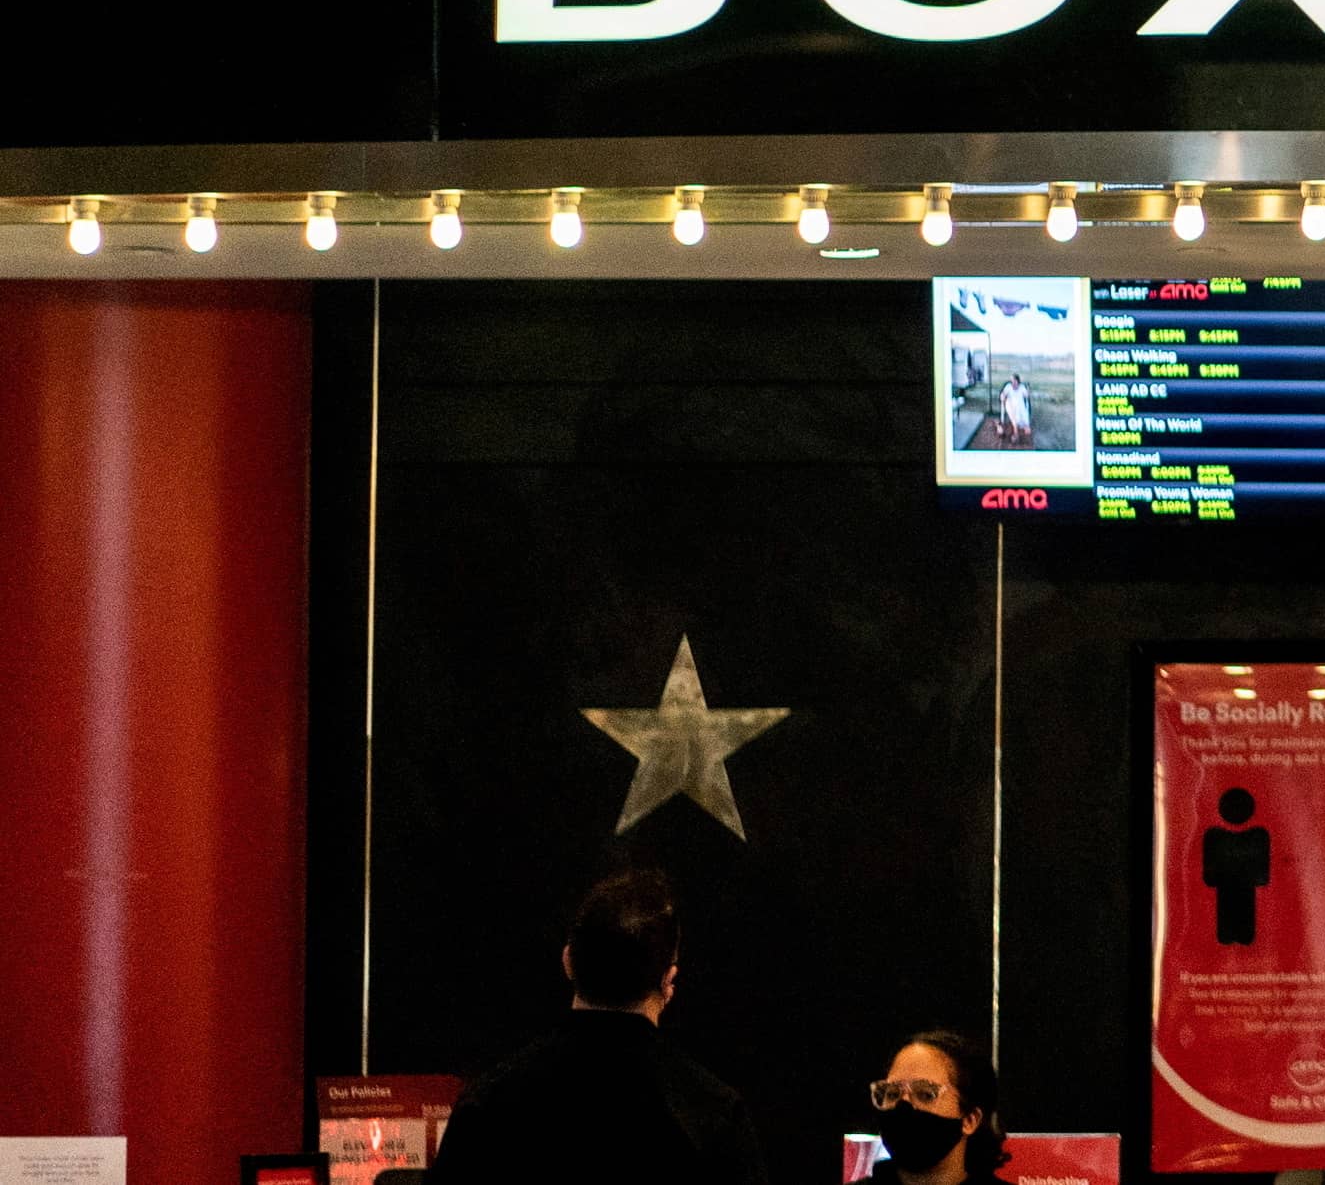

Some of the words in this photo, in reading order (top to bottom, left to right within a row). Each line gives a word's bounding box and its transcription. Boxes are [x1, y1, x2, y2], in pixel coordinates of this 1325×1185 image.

[1110, 284, 1148, 300] Laser
[1095, 349, 1130, 362] Chaos
[1131, 349, 1177, 364] Walking
[1095, 383, 1128, 397] LAND
[1144, 417, 1166, 432] The
[1167, 418, 1202, 433] World
[1096, 451, 1160, 465] Nomadland
[981, 488, 1048, 511] amc
[1097, 485, 1153, 501] Promising
[1154, 486, 1190, 501] Young
[1191, 487, 1235, 501] Woman
[1180, 701, 1210, 723] Be
[1215, 701, 1303, 728] Socially
[329, 1087, 349, 1100] Our
[351, 1084, 392, 1099] Policies
